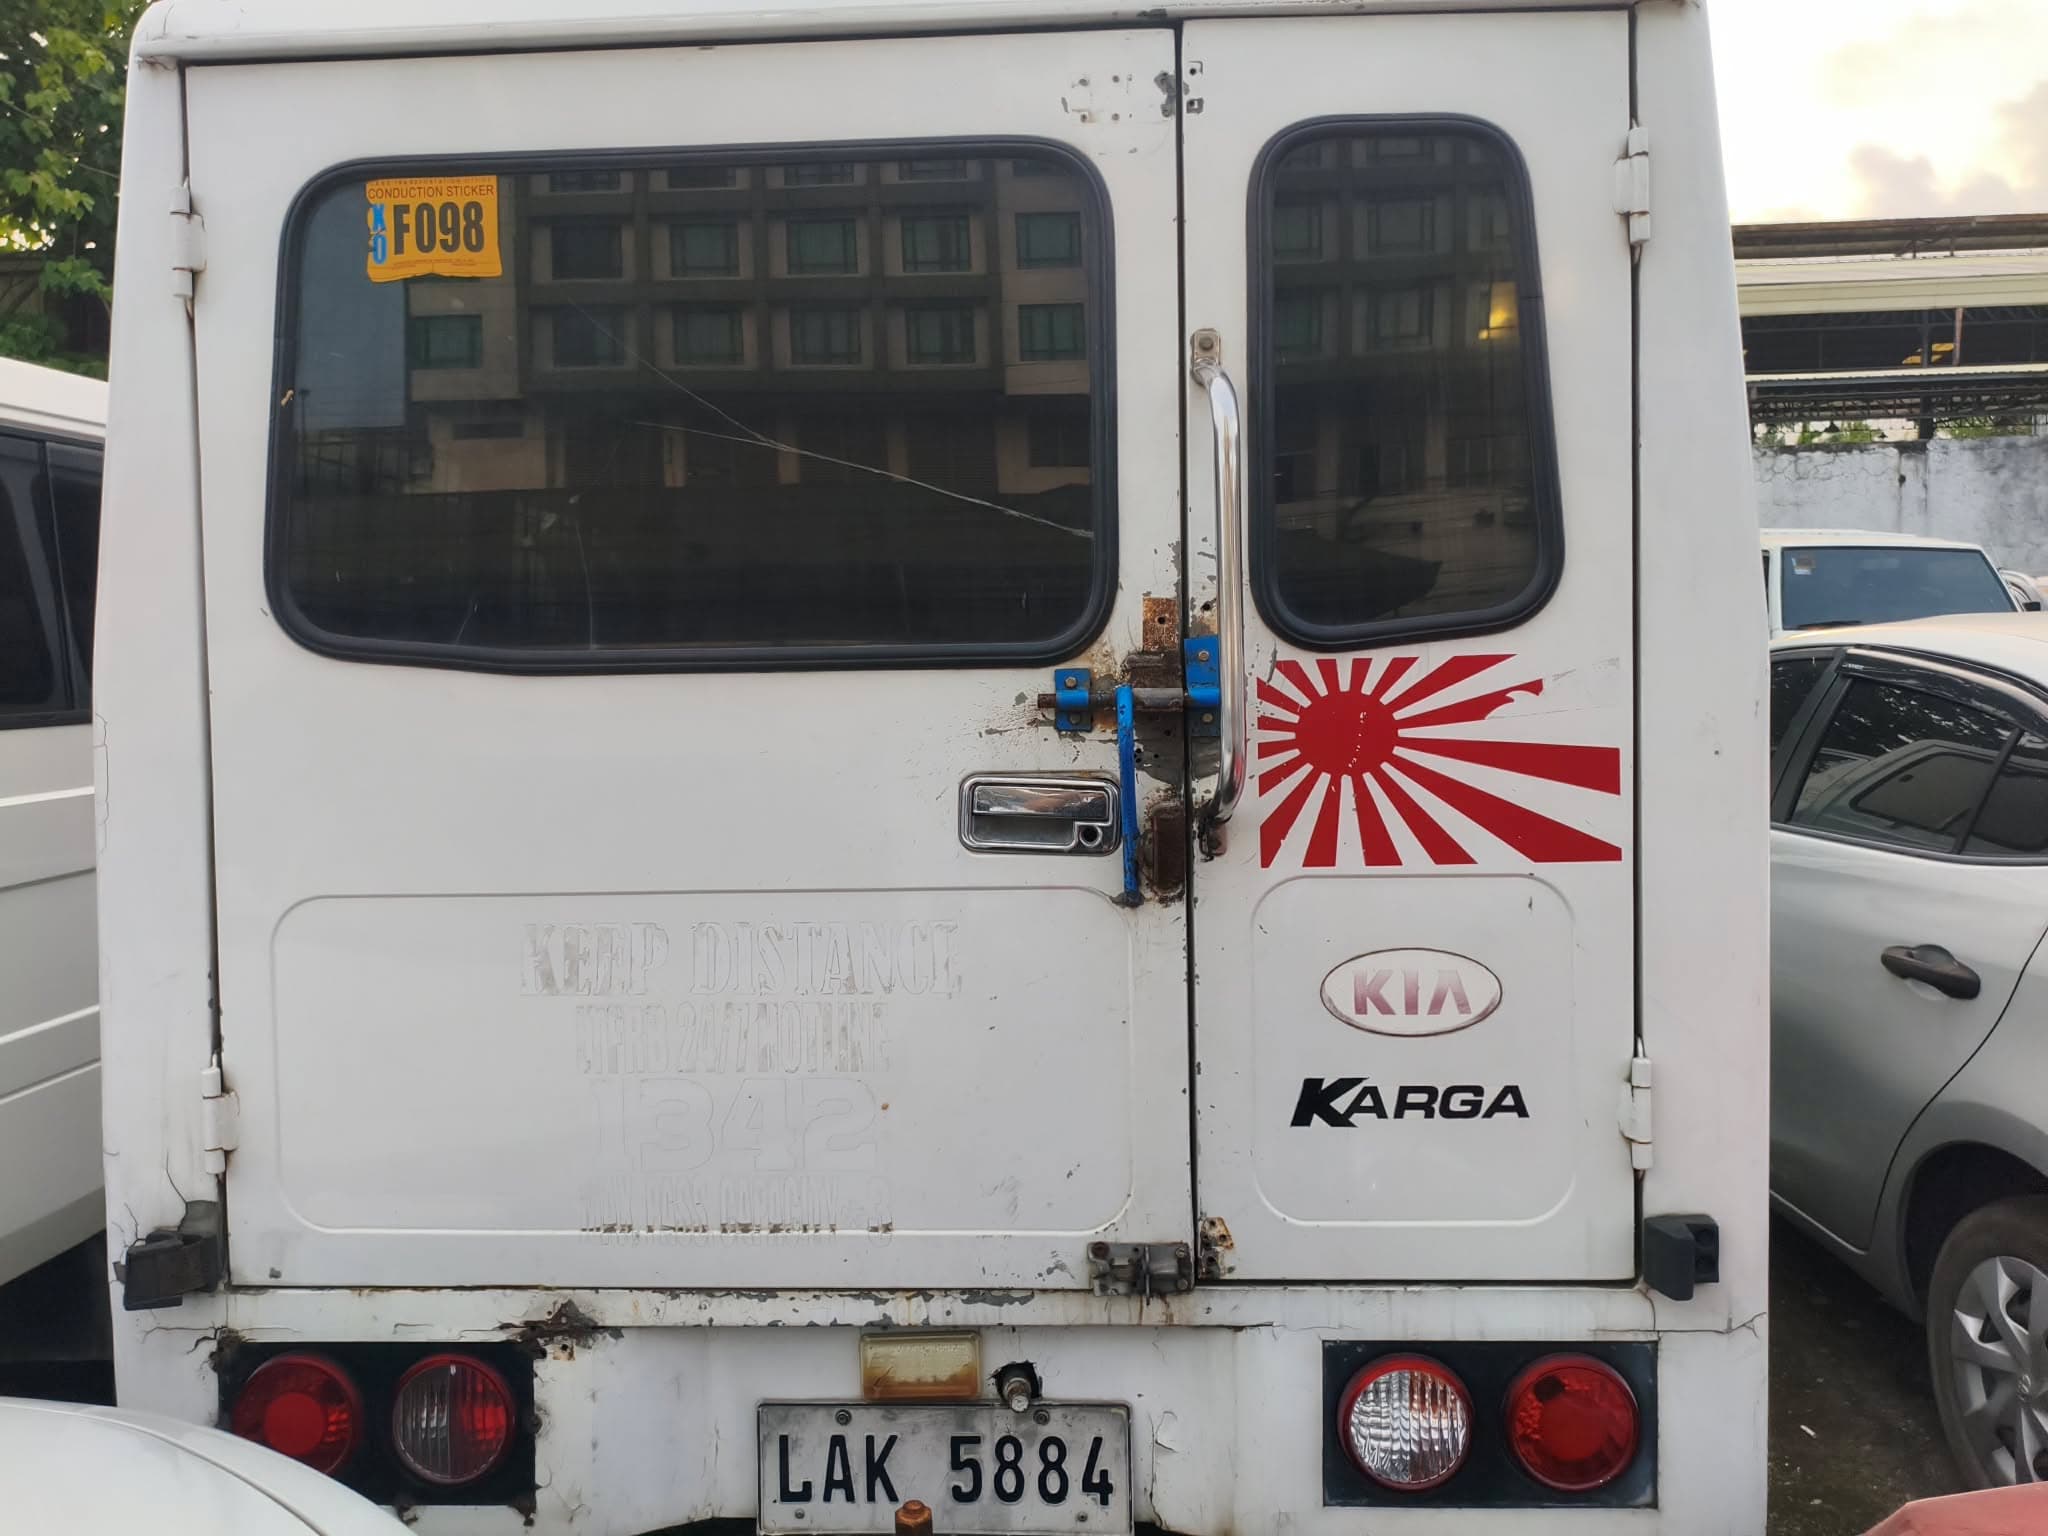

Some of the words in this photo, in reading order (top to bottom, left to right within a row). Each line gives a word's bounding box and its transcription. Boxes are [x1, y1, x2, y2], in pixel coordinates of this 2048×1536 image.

[368, 186, 443, 200] CONDUCTION
[446, 184, 495, 198] STICKER
[393, 201, 485, 255] F098
[520, 921, 669, 997] KEEP
[688, 919, 963, 998] DISTANCE
[1352, 968, 1473, 1015] KIA
[591, 1077, 880, 1173] 1342
[1290, 1077, 1531, 1128] KARGA
[778, 1434, 900, 1504] LAK
[949, 1434, 1115, 1506] 5884
